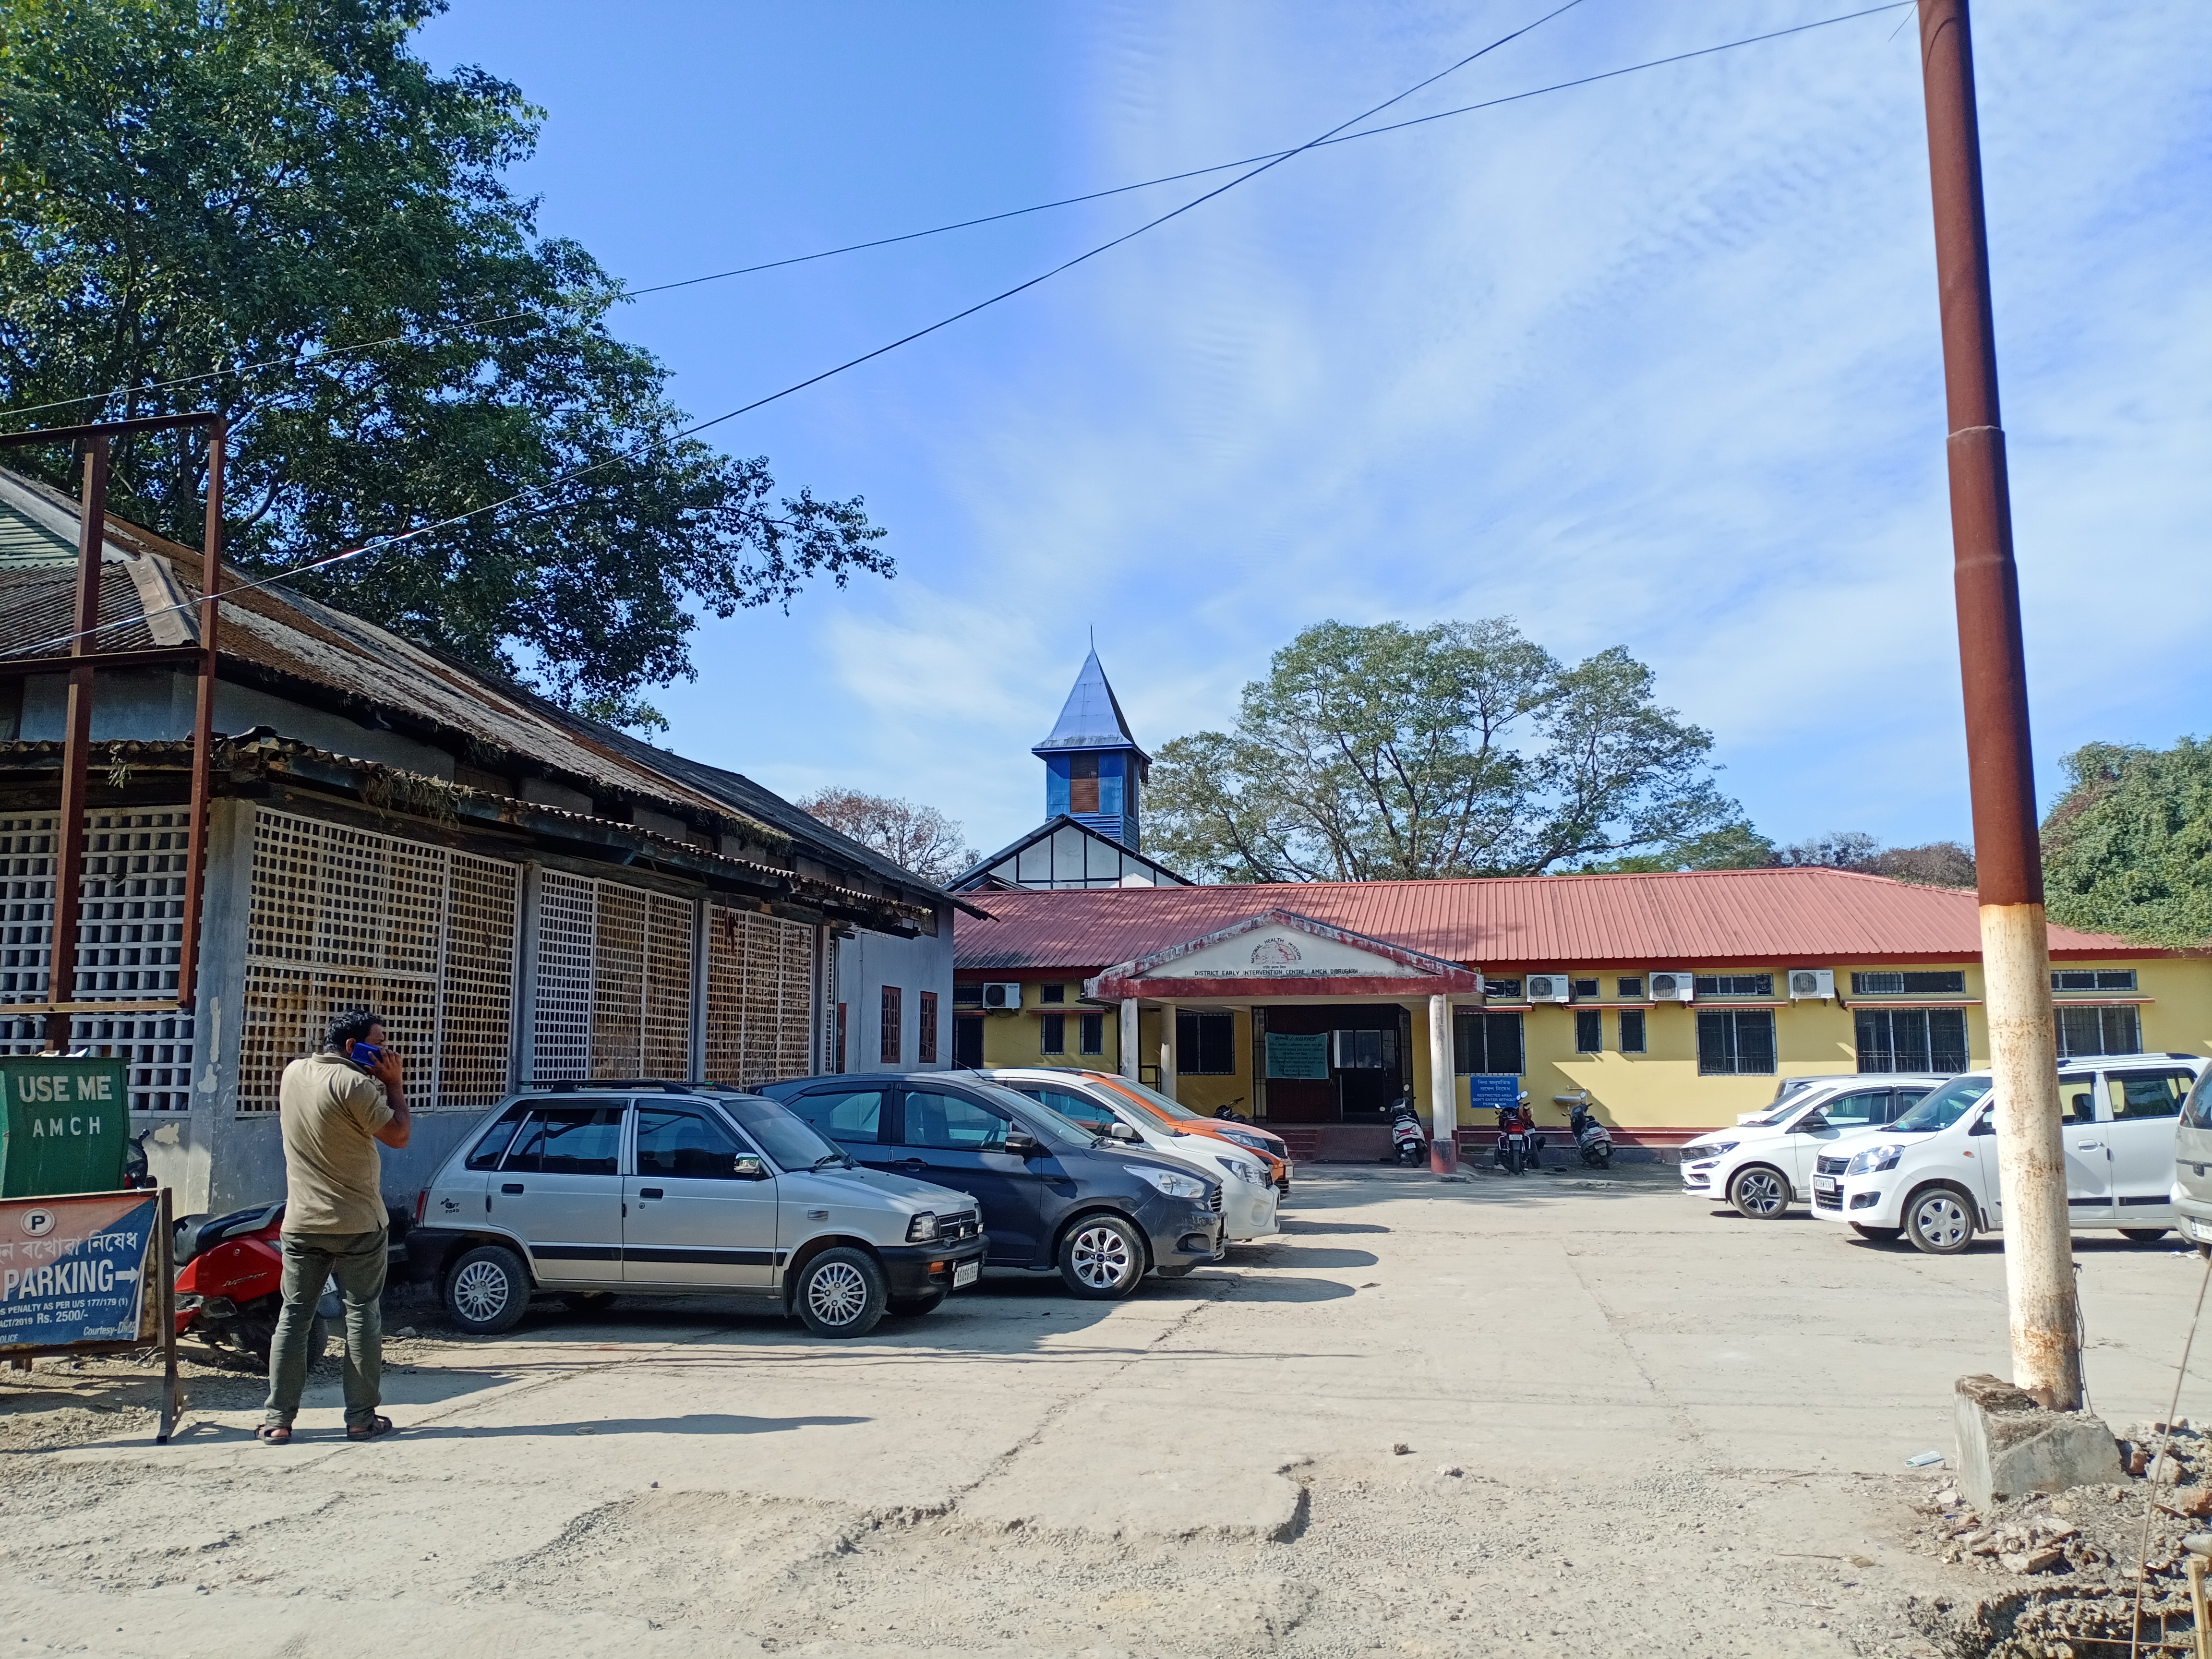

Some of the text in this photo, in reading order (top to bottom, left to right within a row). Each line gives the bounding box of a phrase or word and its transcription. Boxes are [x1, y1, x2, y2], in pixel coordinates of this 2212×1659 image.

[1250, 944, 1263, 963] NATIONAL
[1288, 942, 1302, 960] MISSION
[18, 1075, 112, 1103] USE ME
[31, 1215, 45, 1230] P
[86, 1229, 138, 1253] নিষেধ
[2, 1259, 113, 1302] PARKING
[8, 1303, 41, 1314] PENALTY
[43, 1302, 53, 1310] AS
[56, 1301, 70, 1310] PER
[72, 1299, 85, 1309] U/S
[87, 1298, 116, 1307] 177/179
[119, 1298, 128, 1307] (1)
[37, 1313, 52, 1324] Rs.
[56, 1309, 88, 1323] 2500/-
